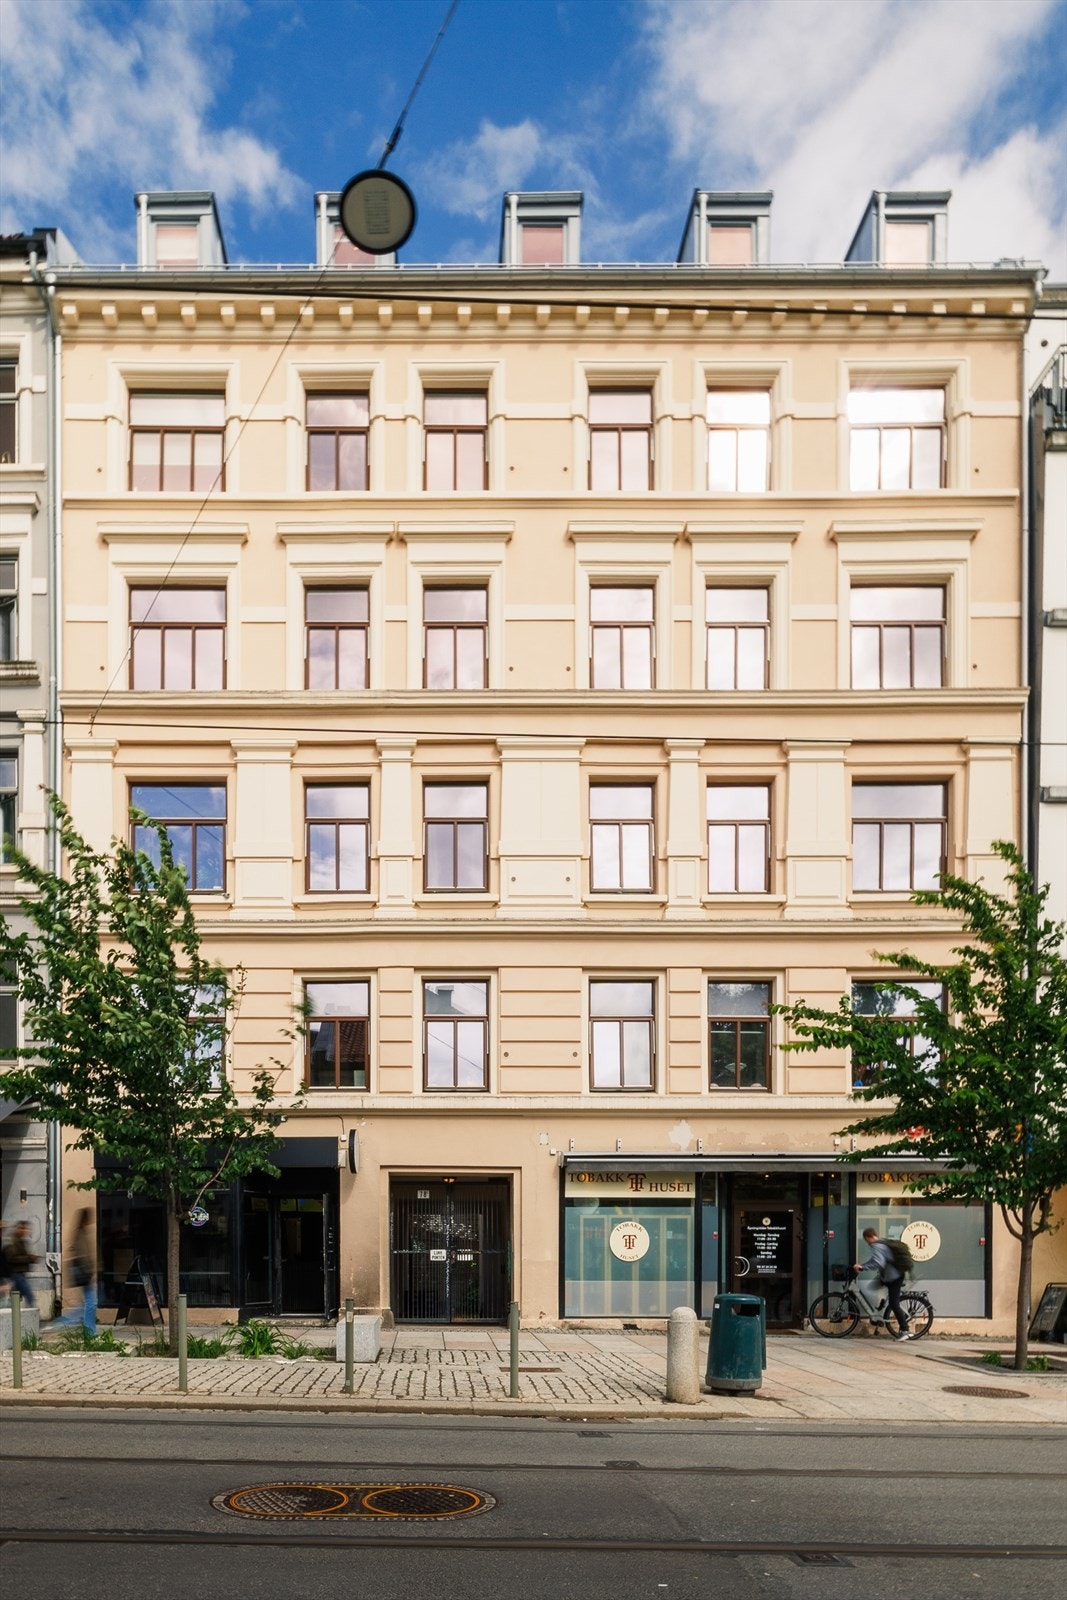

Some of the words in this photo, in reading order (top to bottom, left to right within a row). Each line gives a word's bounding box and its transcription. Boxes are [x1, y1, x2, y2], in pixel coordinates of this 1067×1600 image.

[568, 1172, 624, 1183] TOBAKK
[649, 1182, 693, 1192] HUSET
[860, 1172, 915, 1183] TOBAKK
